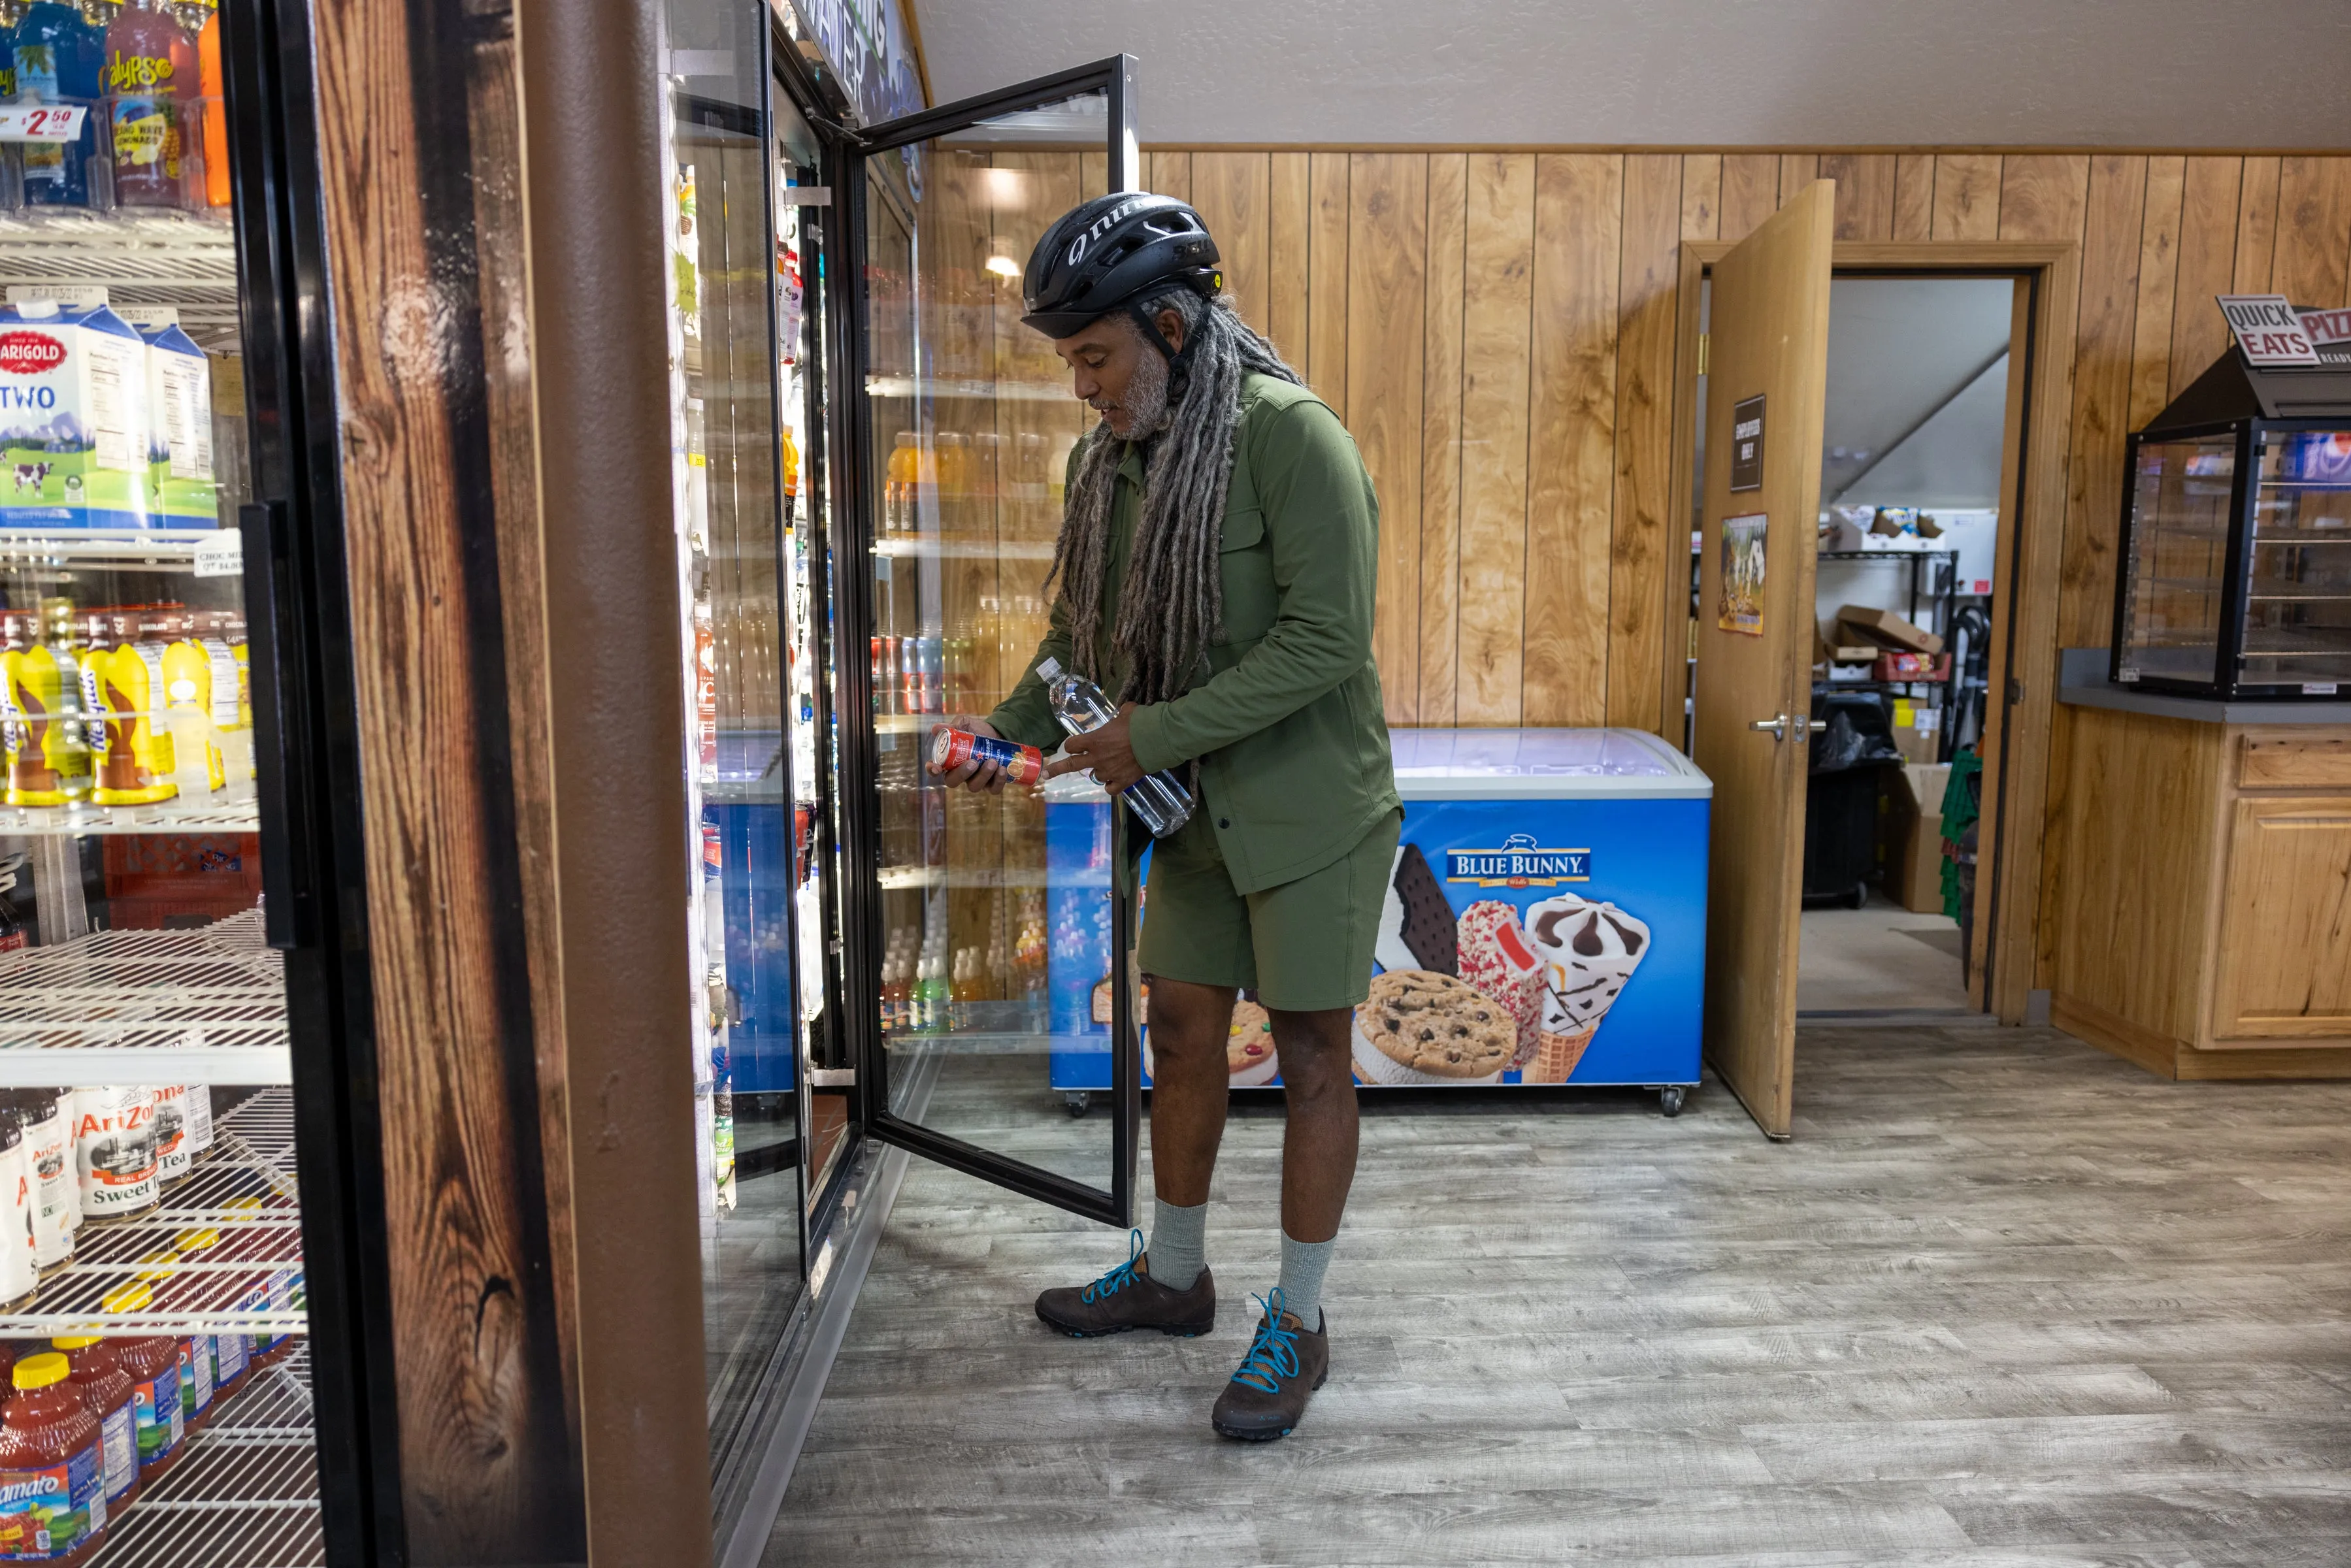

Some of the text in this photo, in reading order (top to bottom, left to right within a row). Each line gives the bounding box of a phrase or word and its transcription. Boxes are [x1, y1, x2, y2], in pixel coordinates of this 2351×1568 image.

[2227, 304, 2297, 331] QUICK
[2241, 333, 2310, 355] EATS
[0, 386, 55, 408] TWO
[199, 553, 224, 561] CHOC
[1456, 855, 1582, 875] BLUE BUNNY
[157, 1145, 173, 1154] WED
[159, 1152, 186, 1169] Tea
[114, 1175, 136, 1184] REAL
[93, 1181, 150, 1204] Sweet
